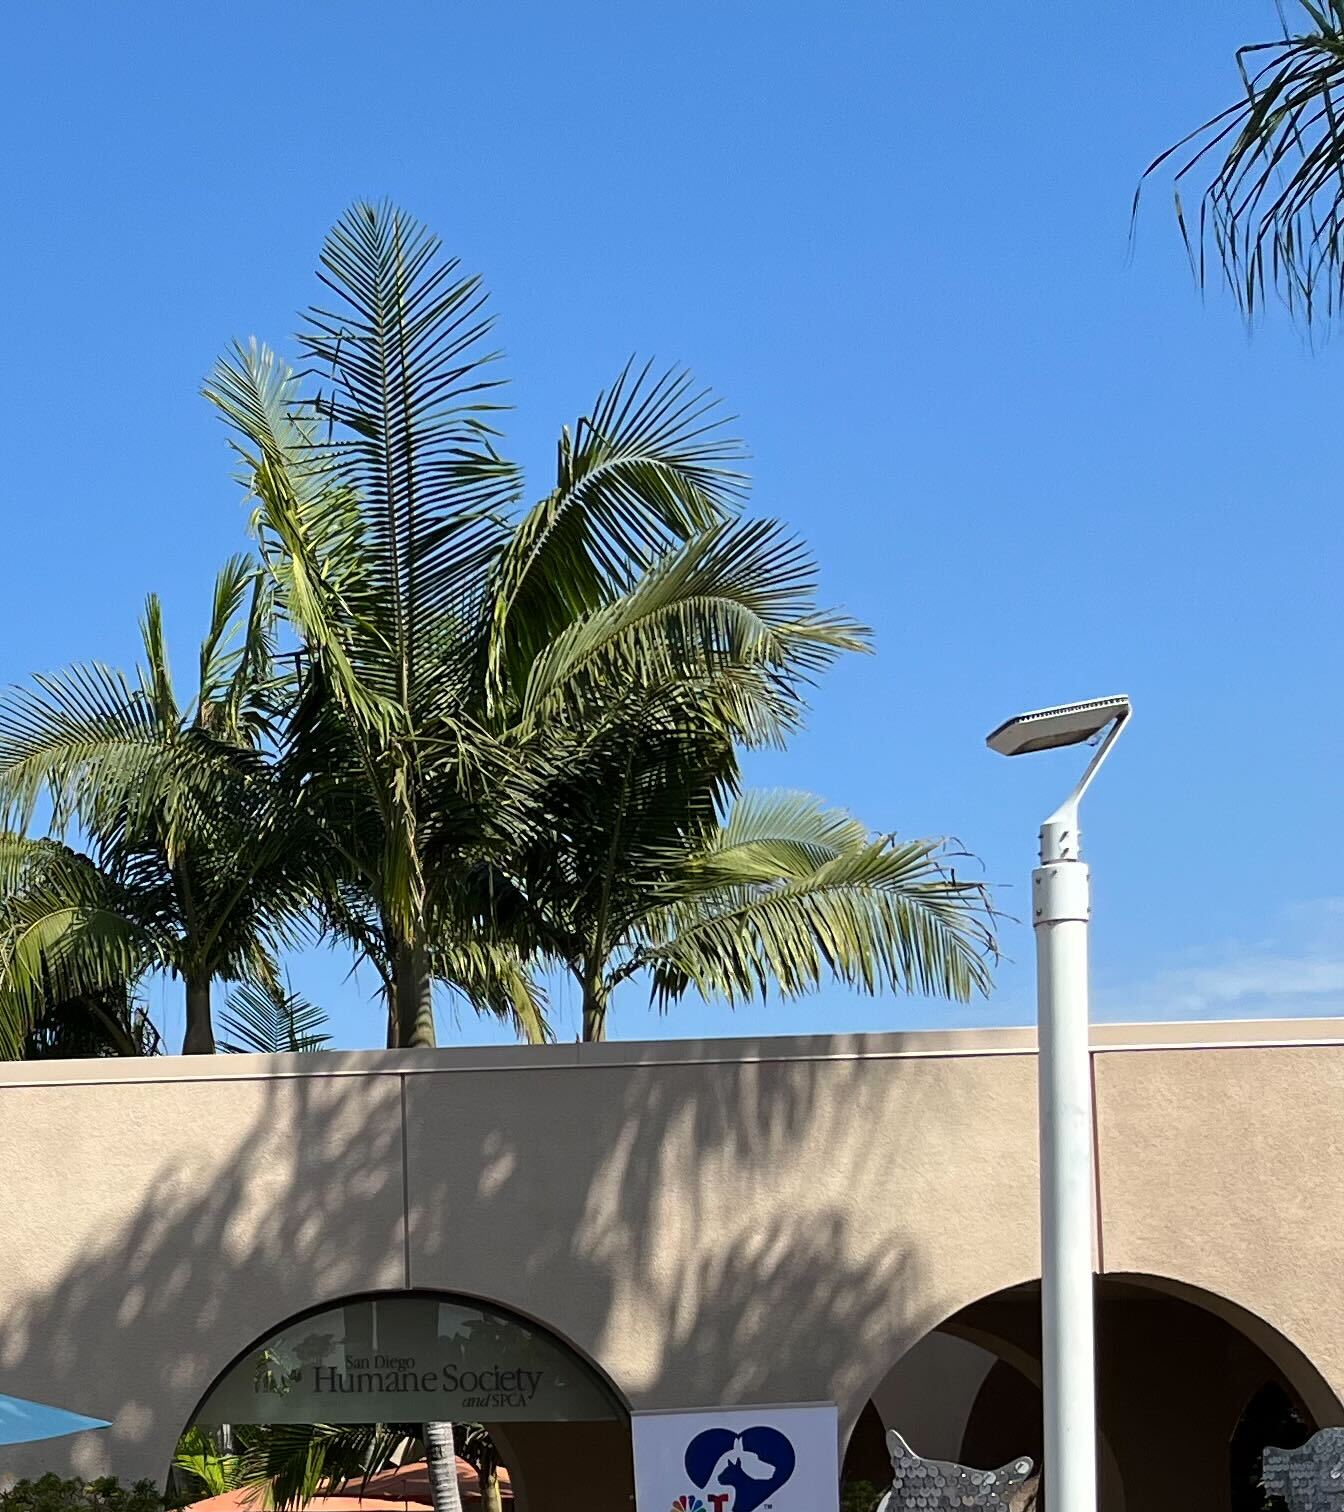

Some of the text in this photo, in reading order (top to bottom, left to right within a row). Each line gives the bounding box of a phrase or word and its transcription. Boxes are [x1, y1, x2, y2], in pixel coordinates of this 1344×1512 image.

[345, 1354, 416, 1373] San Diego
[312, 1364, 543, 1398] Humane Society
[462, 1393, 527, 1408] and SPCA
